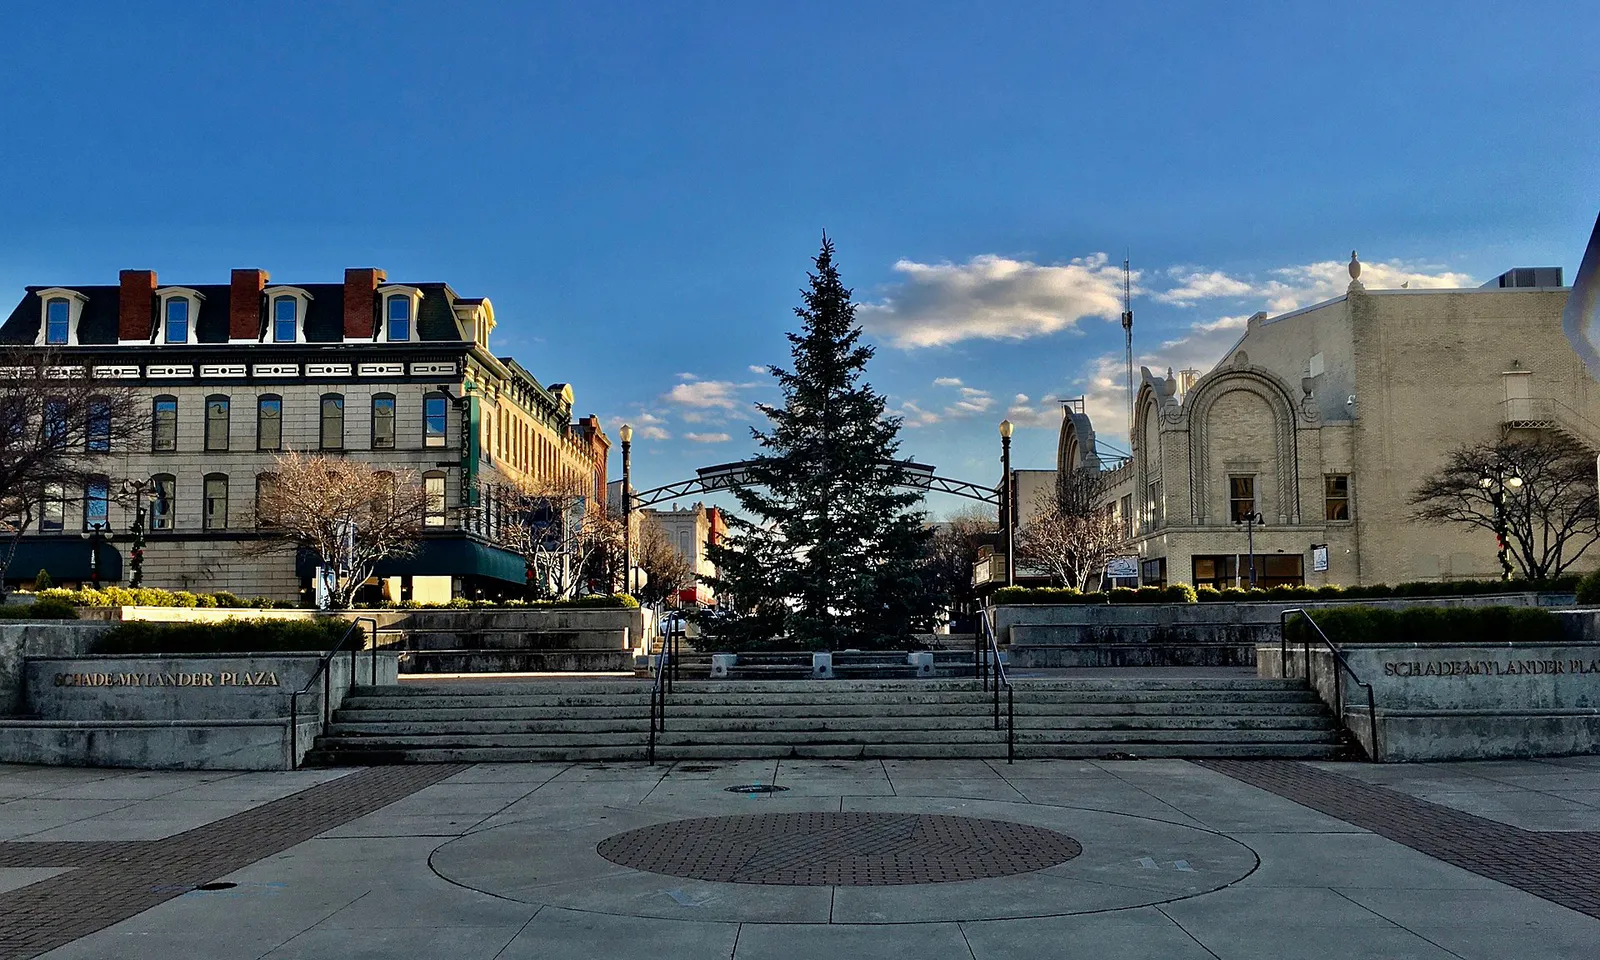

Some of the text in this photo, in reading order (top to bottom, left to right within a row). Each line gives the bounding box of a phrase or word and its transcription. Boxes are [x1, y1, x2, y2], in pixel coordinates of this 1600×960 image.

[1569, 658, 1600, 675] PLA
[54, 671, 280, 688] SCHADE-MYLANDER PLAZA
